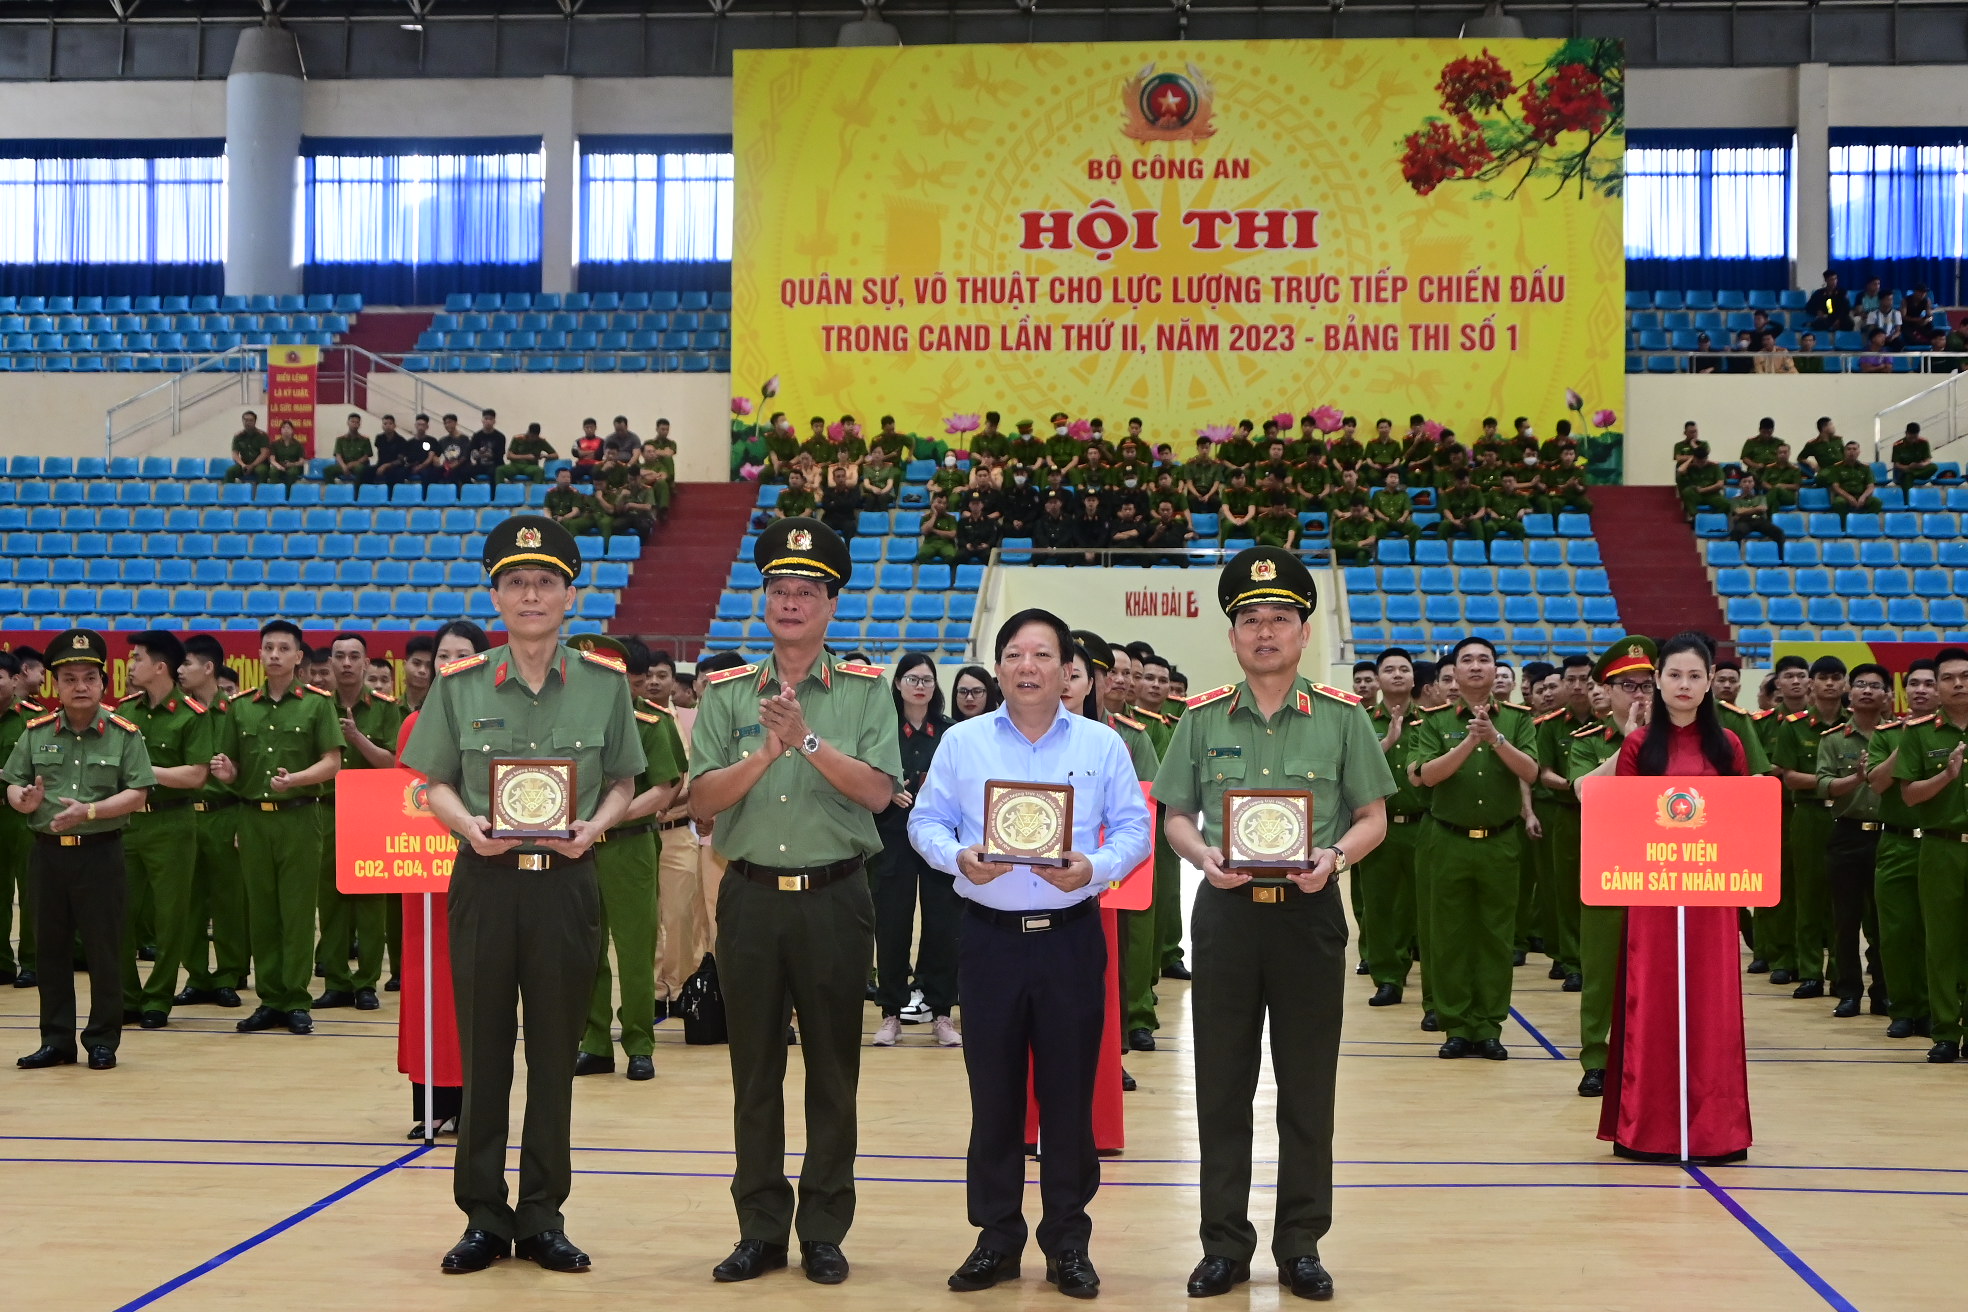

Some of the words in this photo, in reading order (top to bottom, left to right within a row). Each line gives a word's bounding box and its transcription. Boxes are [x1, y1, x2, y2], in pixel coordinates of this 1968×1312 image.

[1088, 154, 1124, 184] BỘ
[1132, 154, 1204, 181] CÔNG
[1212, 158, 1251, 180] AN
[1020, 199, 1160, 261] HỘI
[1183, 210, 1319, 250] THI
[781, 272, 853, 308] QUÂN
[863, 274, 906, 310] SỰ,
[913, 272, 948, 304] VÕ
[956, 271, 1040, 310] THUẬT
[1049, 276, 1104, 304] CHO
[1112, 273, 1164, 310] LỰC
[1171, 273, 1262, 310] LƯỢNG
[1271, 273, 1341, 310] TRỰC
[1350, 266, 1409, 304] TIẾP
[1418, 265, 1501, 304] CHIẾN
[1510, 264, 1565, 303] ĐẤU
[821, 324, 909, 352] TRONG
[918, 324, 991, 352] CAND
[1000, 315, 1053, 351] LẦN
[1061, 318, 1115, 352] THỨ
[1122, 324, 1147, 354] II,
[1157, 317, 1220, 352] NĂM
[1229, 323, 1296, 352] 2023
[1324, 314, 1400, 352] BẢNG
[1408, 323, 1450, 351] THI
[1460, 313, 1496, 351] SỐ
[1507, 323, 1518, 351] 1
[1126, 586, 1157, 616] KHÁN
[386, 832, 420, 853] LIÊN
[426, 834, 459, 854] QUA
[1646, 843, 1677, 865] HỌC
[1682, 839, 1717, 866] VIỆN
[1601, 865, 1643, 890] CẢNH
[1648, 868, 1678, 890] SÁT
[1682, 869, 1725, 891] NHÂN
[1730, 869, 1762, 891] DÂN
